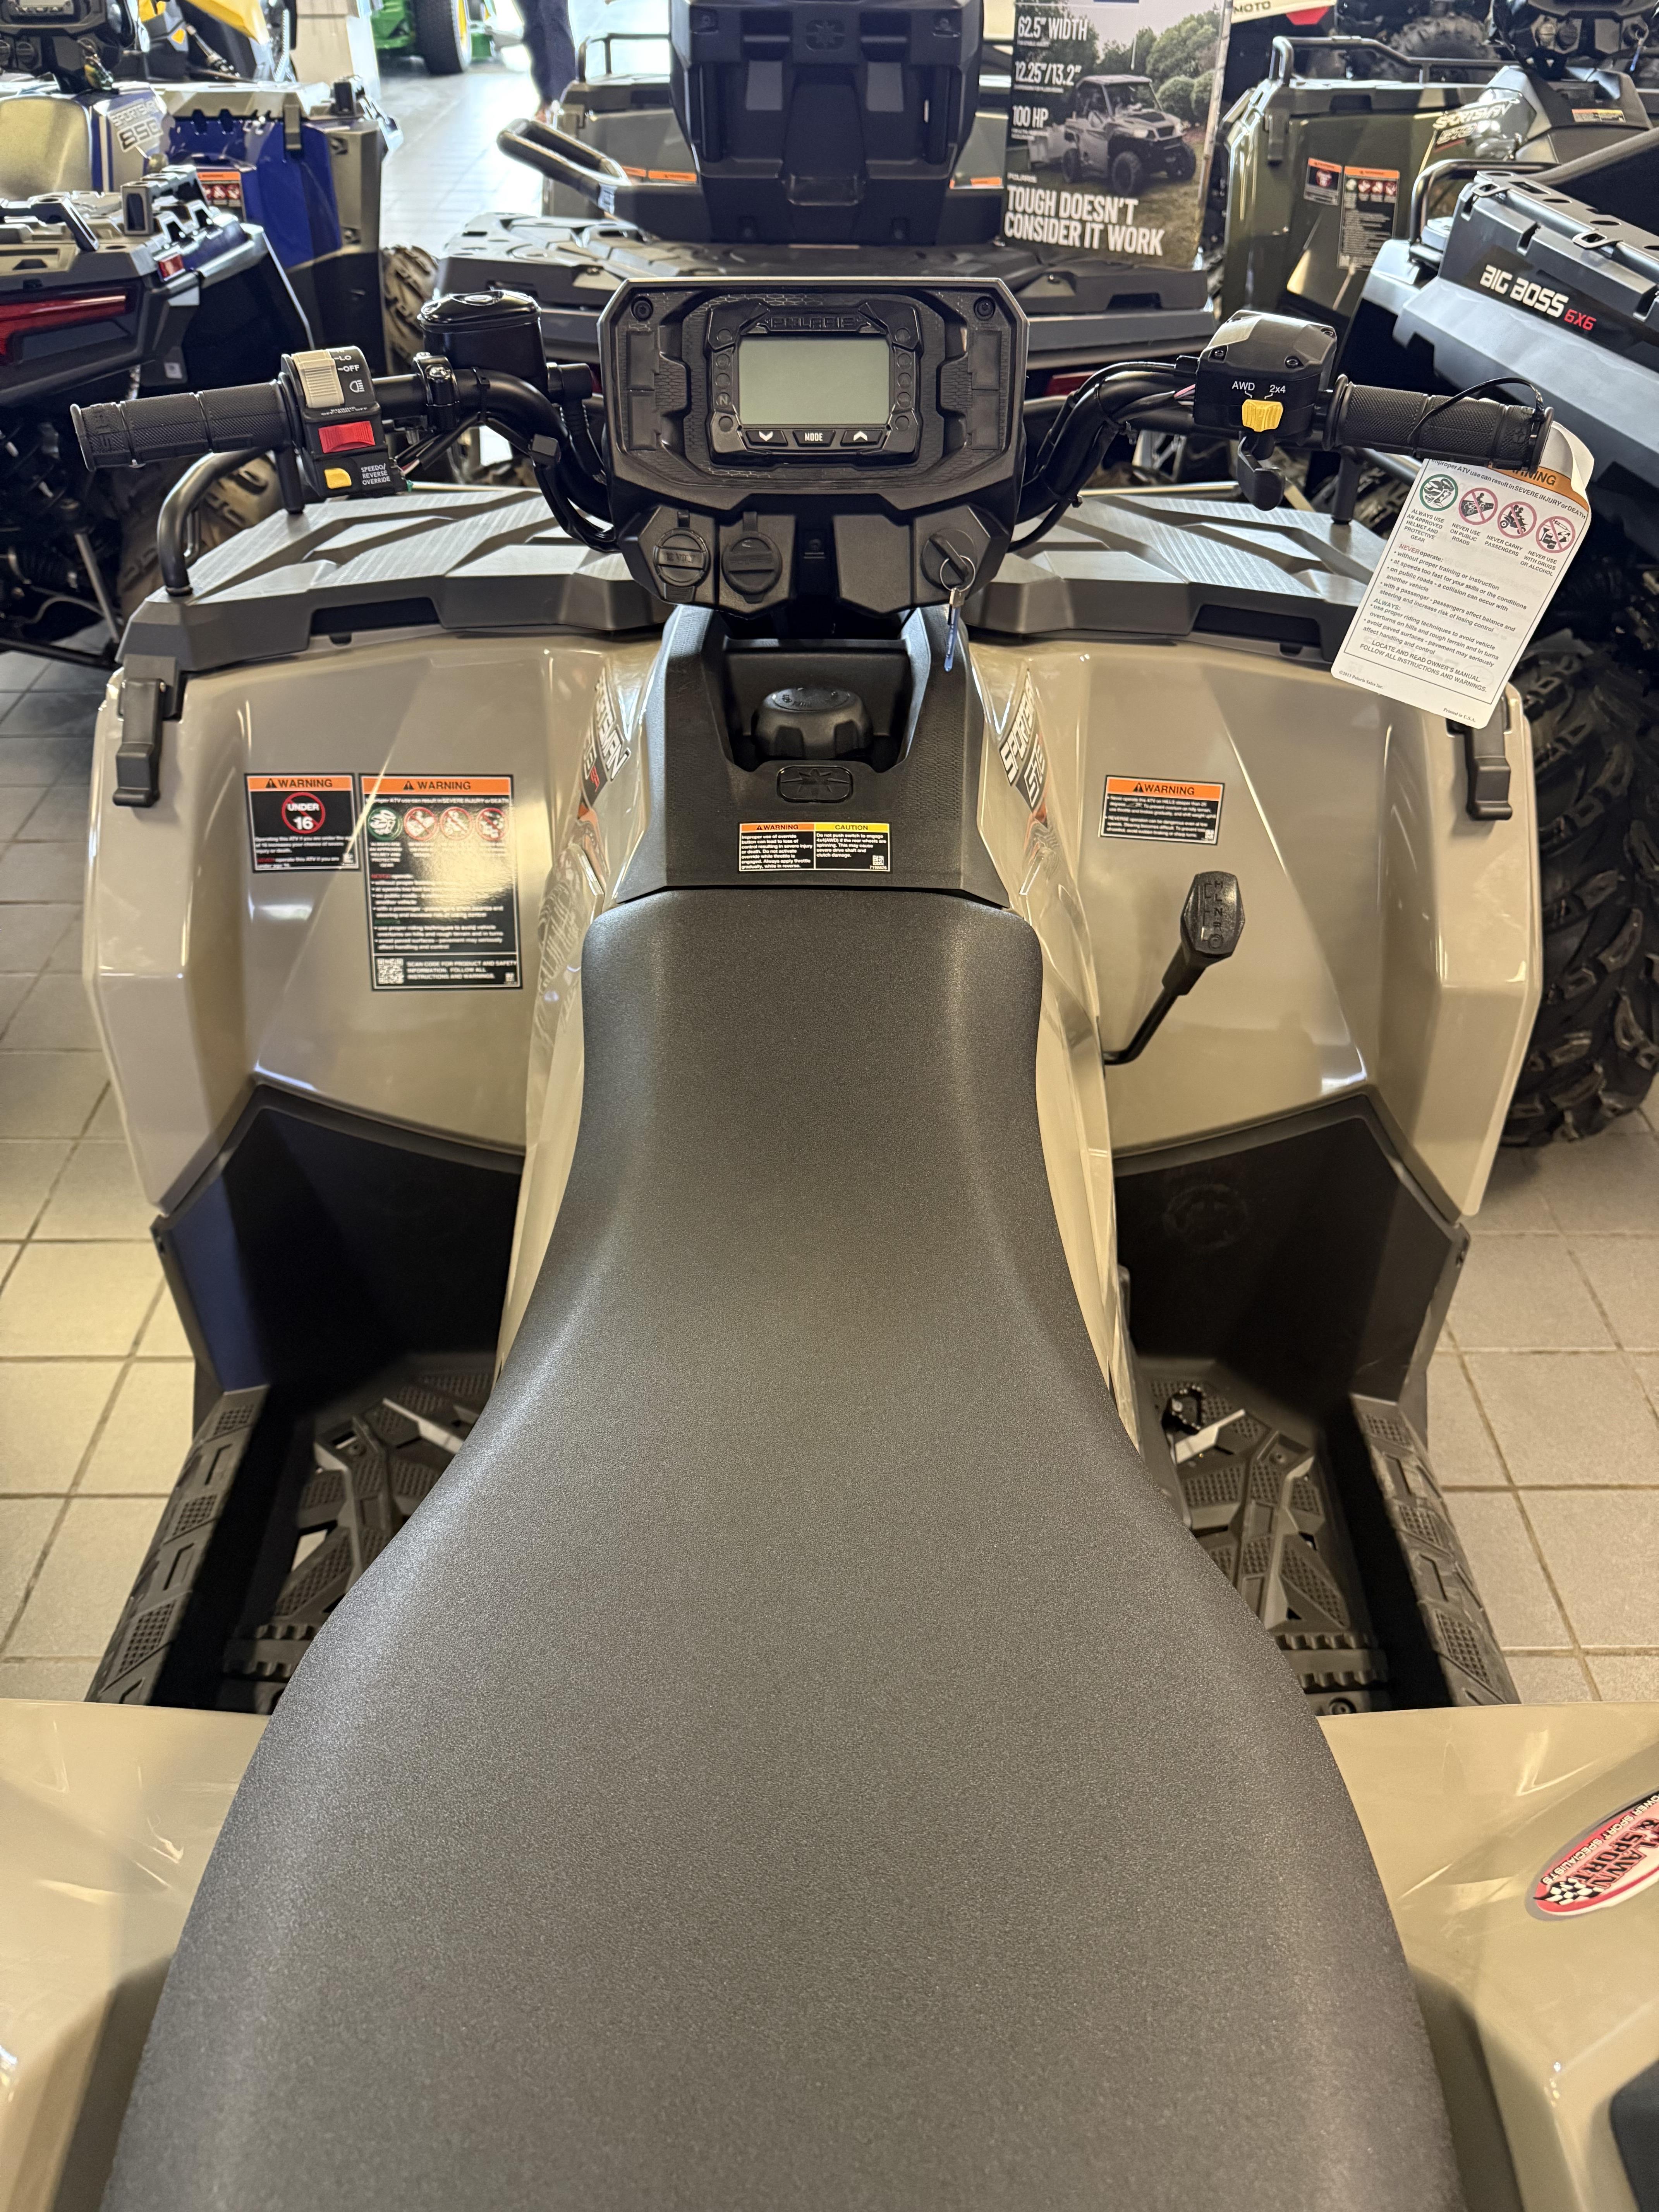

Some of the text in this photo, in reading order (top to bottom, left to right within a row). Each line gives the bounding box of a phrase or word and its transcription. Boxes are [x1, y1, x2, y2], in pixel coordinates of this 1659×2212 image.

[1048, 17, 1088, 41] WIDTH
[1012, 105, 1049, 128] 100 HP
[1006, 185, 1139, 225] TOUGH DOESN'T
[1004, 211, 1165, 256] CONSIDER IT WORK
[1480, 264, 1597, 331] BIG BOSS 6X6
[343, 364, 360, 372] OFF
[1231, 381, 1286, 394] AWD 2x4
[804, 432, 823, 442] MODE
[361, 463, 386, 472] SPEEDO/
[362, 470, 388, 479] REVERSE
[362, 476, 391, 485] OVERRIDE
[1491, 478, 1509, 488] result
[1514, 485, 1539, 498] SEVERE
[1538, 494, 1562, 506] INJURY
[1567, 505, 1589, 519] DEATH
[1410, 508, 1433, 519] ALWAYS
[1406, 520, 1427, 530] HELMET
[1414, 516, 1443, 529] APPROVED
[1451, 522, 1469, 532] NEVER
[1403, 526, 1436, 540] PROTECTIVE
[1410, 534, 1425, 543] GEAR
[1458, 531, 1477, 541] PUBLIC
[1451, 536, 1470, 546] ROADS
[1486, 534, 1523, 551] NEVER CARRY
[1399, 543, 1443, 562] NEVER operate:
[1484, 541, 1519, 556] PASSENGERS
[1527, 550, 1546, 560] NEVER
[1523, 555, 1556, 570] WITH DRUGS
[1397, 551, 1419, 562] without
[1418, 559, 1438, 568] proper
[1439, 565, 1461, 577] training
[1468, 575, 1499, 590] instruction
[1528, 564, 1553, 576] ALCOHOL
[1386, 575, 1429, 592] another vehicle
[1398, 570, 1417, 579] public
[1417, 576, 1433, 585] roads
[1442, 585, 1466, 596] collision
[1478, 598, 1496, 606] occur
[1496, 603, 1508, 611] with
[1400, 562, 1421, 572] speeds
[1431, 571, 1443, 579] fast
[1497, 595, 1527, 610] conditions
[1373, 598, 1401, 611] ALWAYS:
[1360, 643, 1486, 692] FOLLOW ALL INSTRUCTIONS AND WARNINGS.
[1371, 640, 1396, 652] LOCATE
[1409, 653, 1426, 663] READ
[1426, 659, 1455, 673] OWNER'S
[1454, 669, 1480, 682] MANUAL.
[278, 779, 333, 788] WARNING
[417, 781, 471, 790] WARNING
[1144, 784, 1195, 795] WARNING
[287, 802, 320, 811] UNDER
[293, 816, 314, 830] 16
[1542, 1794, 1659, 1885] OWER SPORT SPECIALISTS
[1572, 1833, 1645, 1882] SPORT
[1588, 1839, 1658, 1889] LAWN
